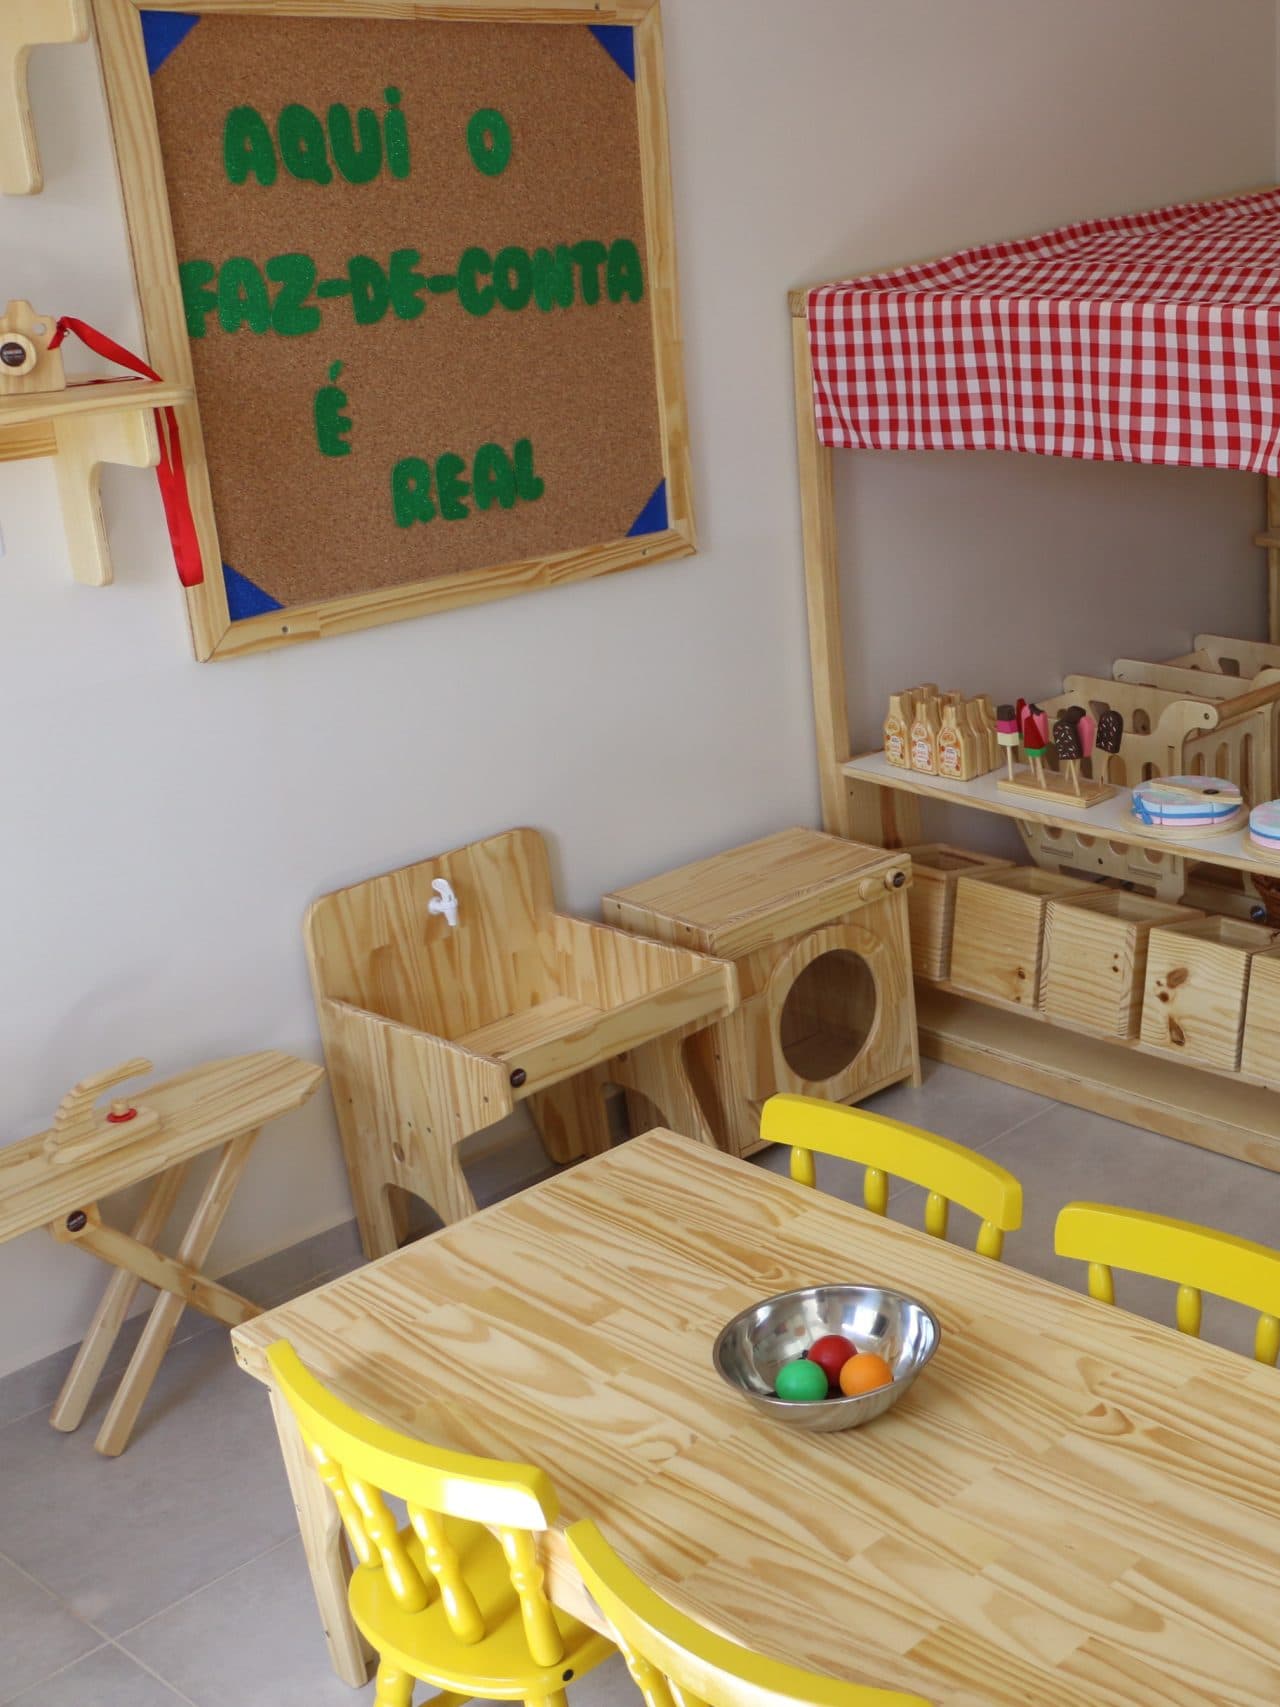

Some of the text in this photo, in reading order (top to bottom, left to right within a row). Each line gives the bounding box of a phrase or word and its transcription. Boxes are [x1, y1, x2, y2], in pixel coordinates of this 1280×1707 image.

[466, 108, 512, 177] O
[180, 239, 644, 338] FAZ-DE-CONTA
[314, 360, 353, 457] É
[391, 439, 545, 529] REAL
